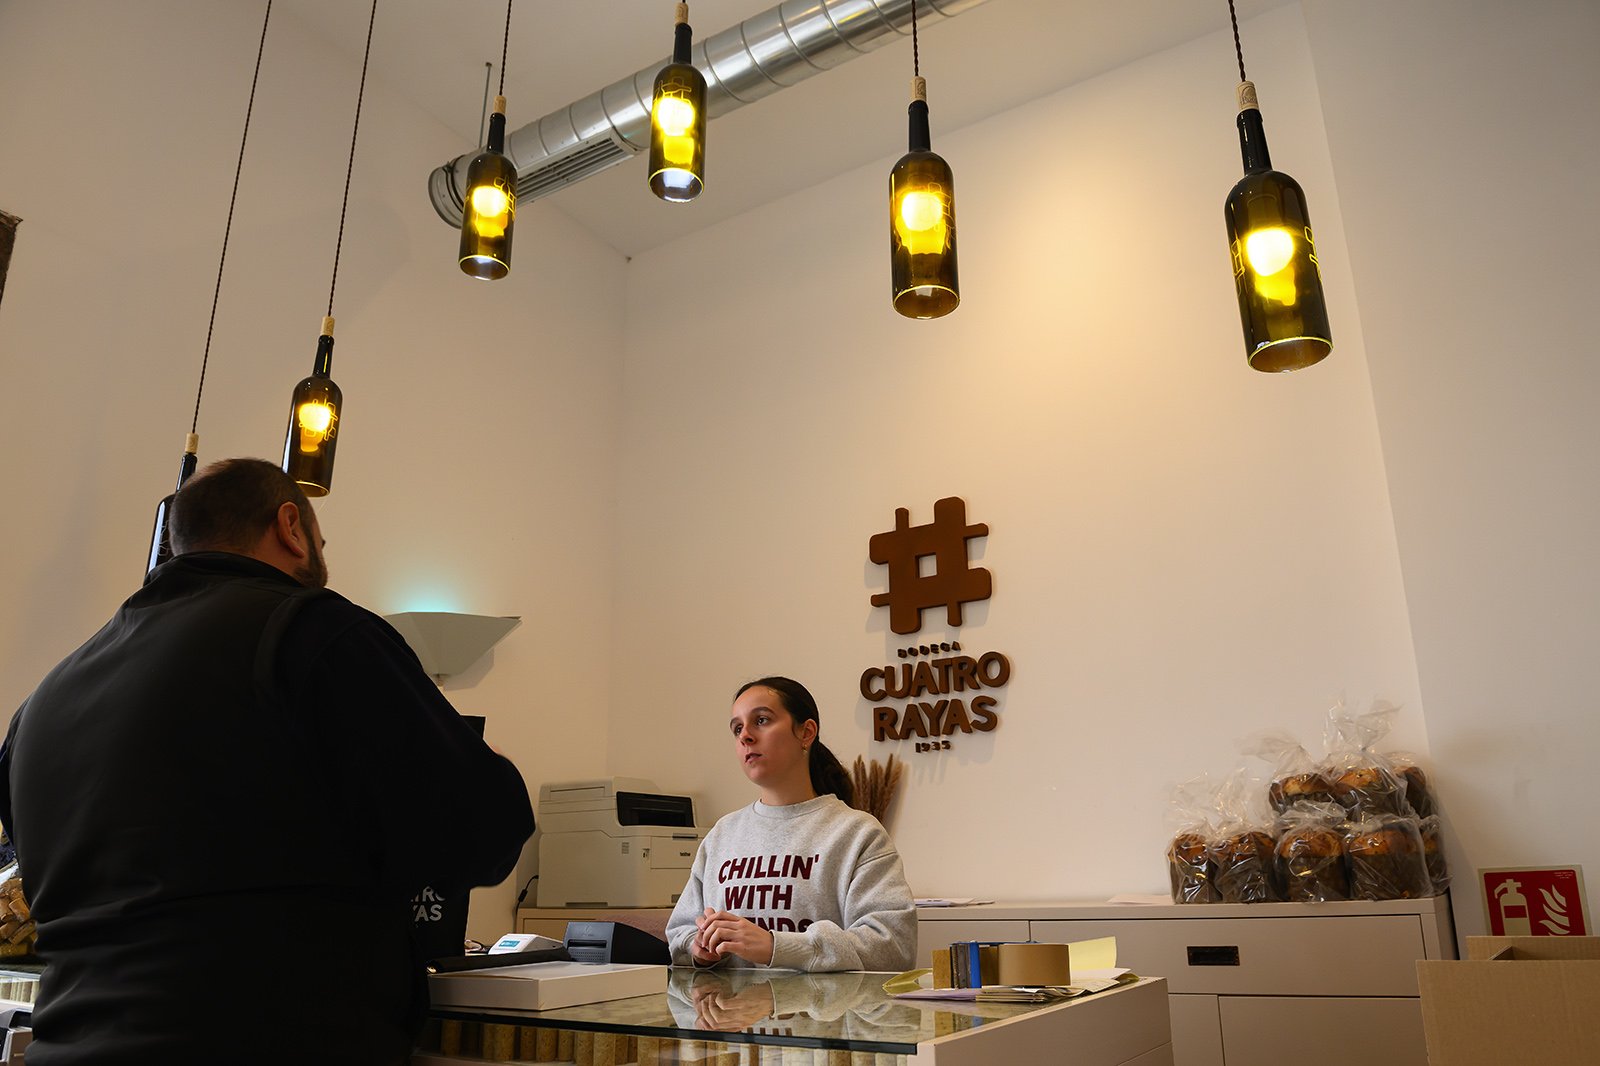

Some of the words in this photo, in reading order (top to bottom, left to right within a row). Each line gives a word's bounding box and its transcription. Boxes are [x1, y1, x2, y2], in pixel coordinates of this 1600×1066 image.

[897, 641, 962, 659] BODEGA
[860, 651, 1011, 702] CUATRO
[873, 695, 998, 742] RAYAS
[915, 740, 951, 753] 1935
[718, 854, 820, 884] CHILLIN'
[725, 885, 793, 911] WITH
